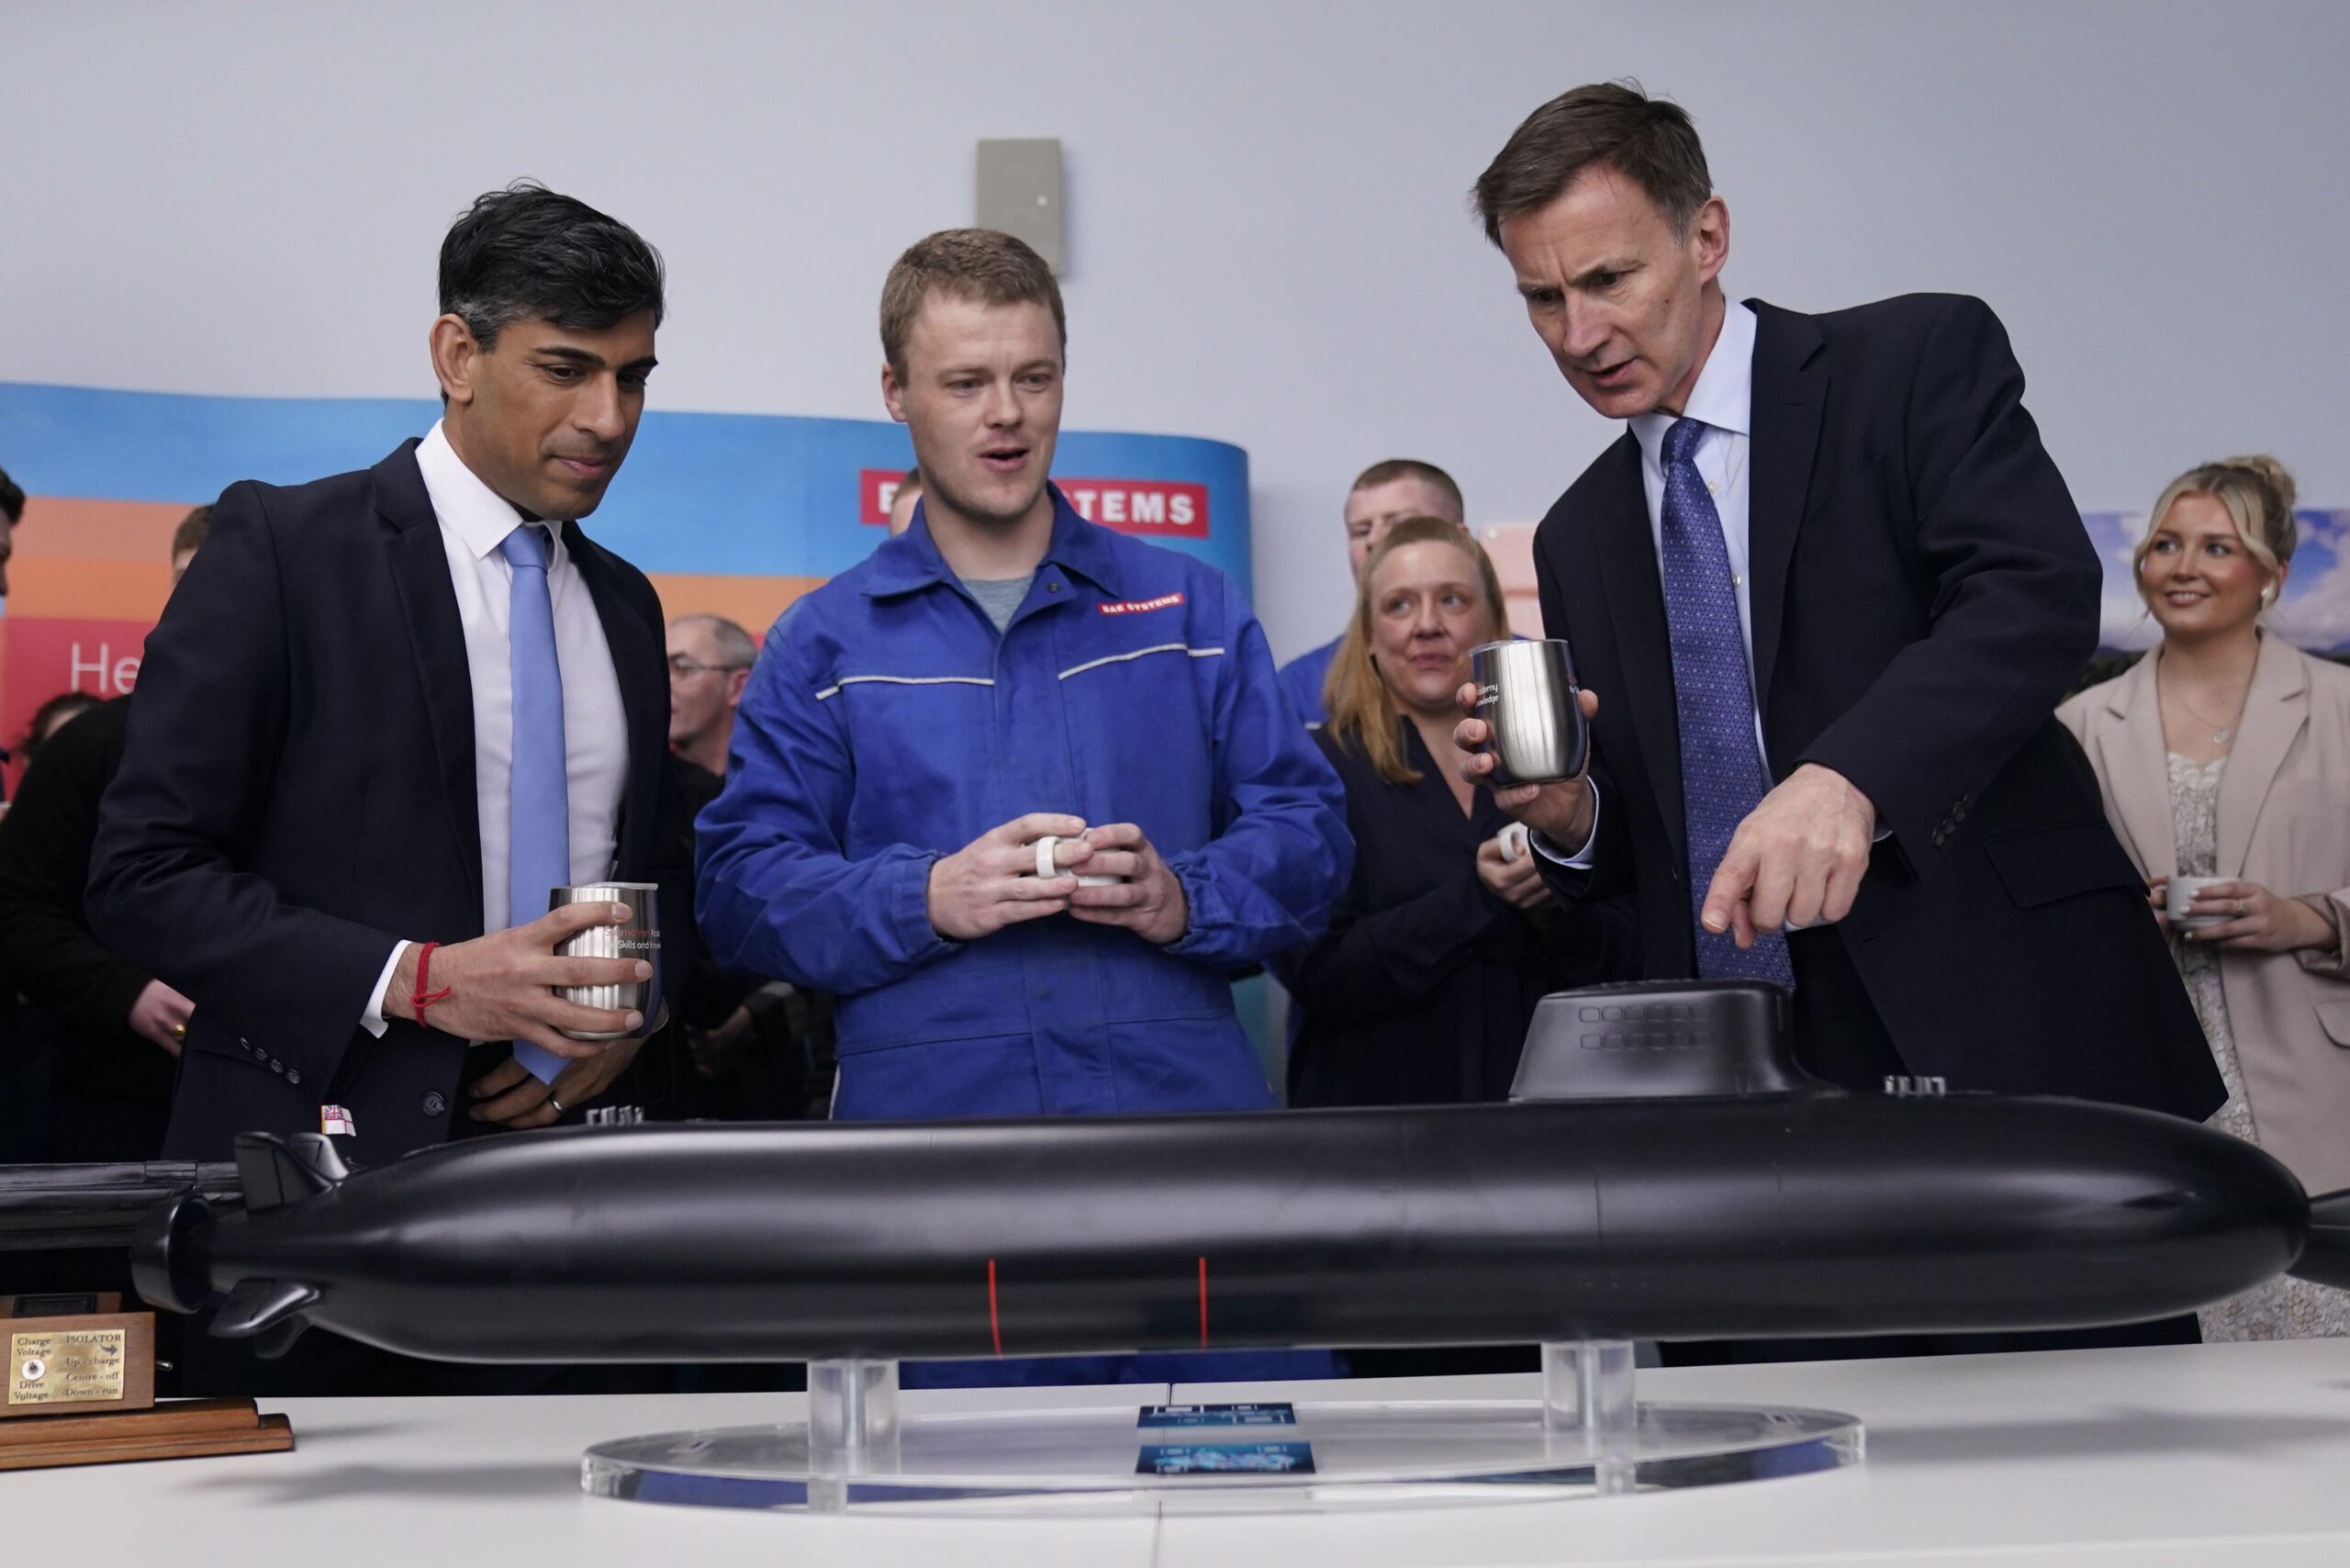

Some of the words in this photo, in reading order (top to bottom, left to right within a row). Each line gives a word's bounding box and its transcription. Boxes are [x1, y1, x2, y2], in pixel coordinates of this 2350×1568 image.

[1062, 489, 1195, 526] TEMS
[1126, 596, 1179, 611] SYSTEMS
[617, 939, 636, 949] Skills
[636, 940, 649, 949] and
[17, 1337, 51, 1347] Charge
[66, 1334, 121, 1344] ISOLATOR
[17, 1348, 51, 1358] Voltage
[66, 1358, 81, 1368] Up
[89, 1356, 120, 1367] charge
[66, 1372, 97, 1382] Centre
[106, 1372, 119, 1380] off
[19, 1381, 45, 1390] Drive
[15, 1392, 49, 1401] Voltage
[65, 1387, 94, 1397] Down
[102, 1388, 118, 1396] run
